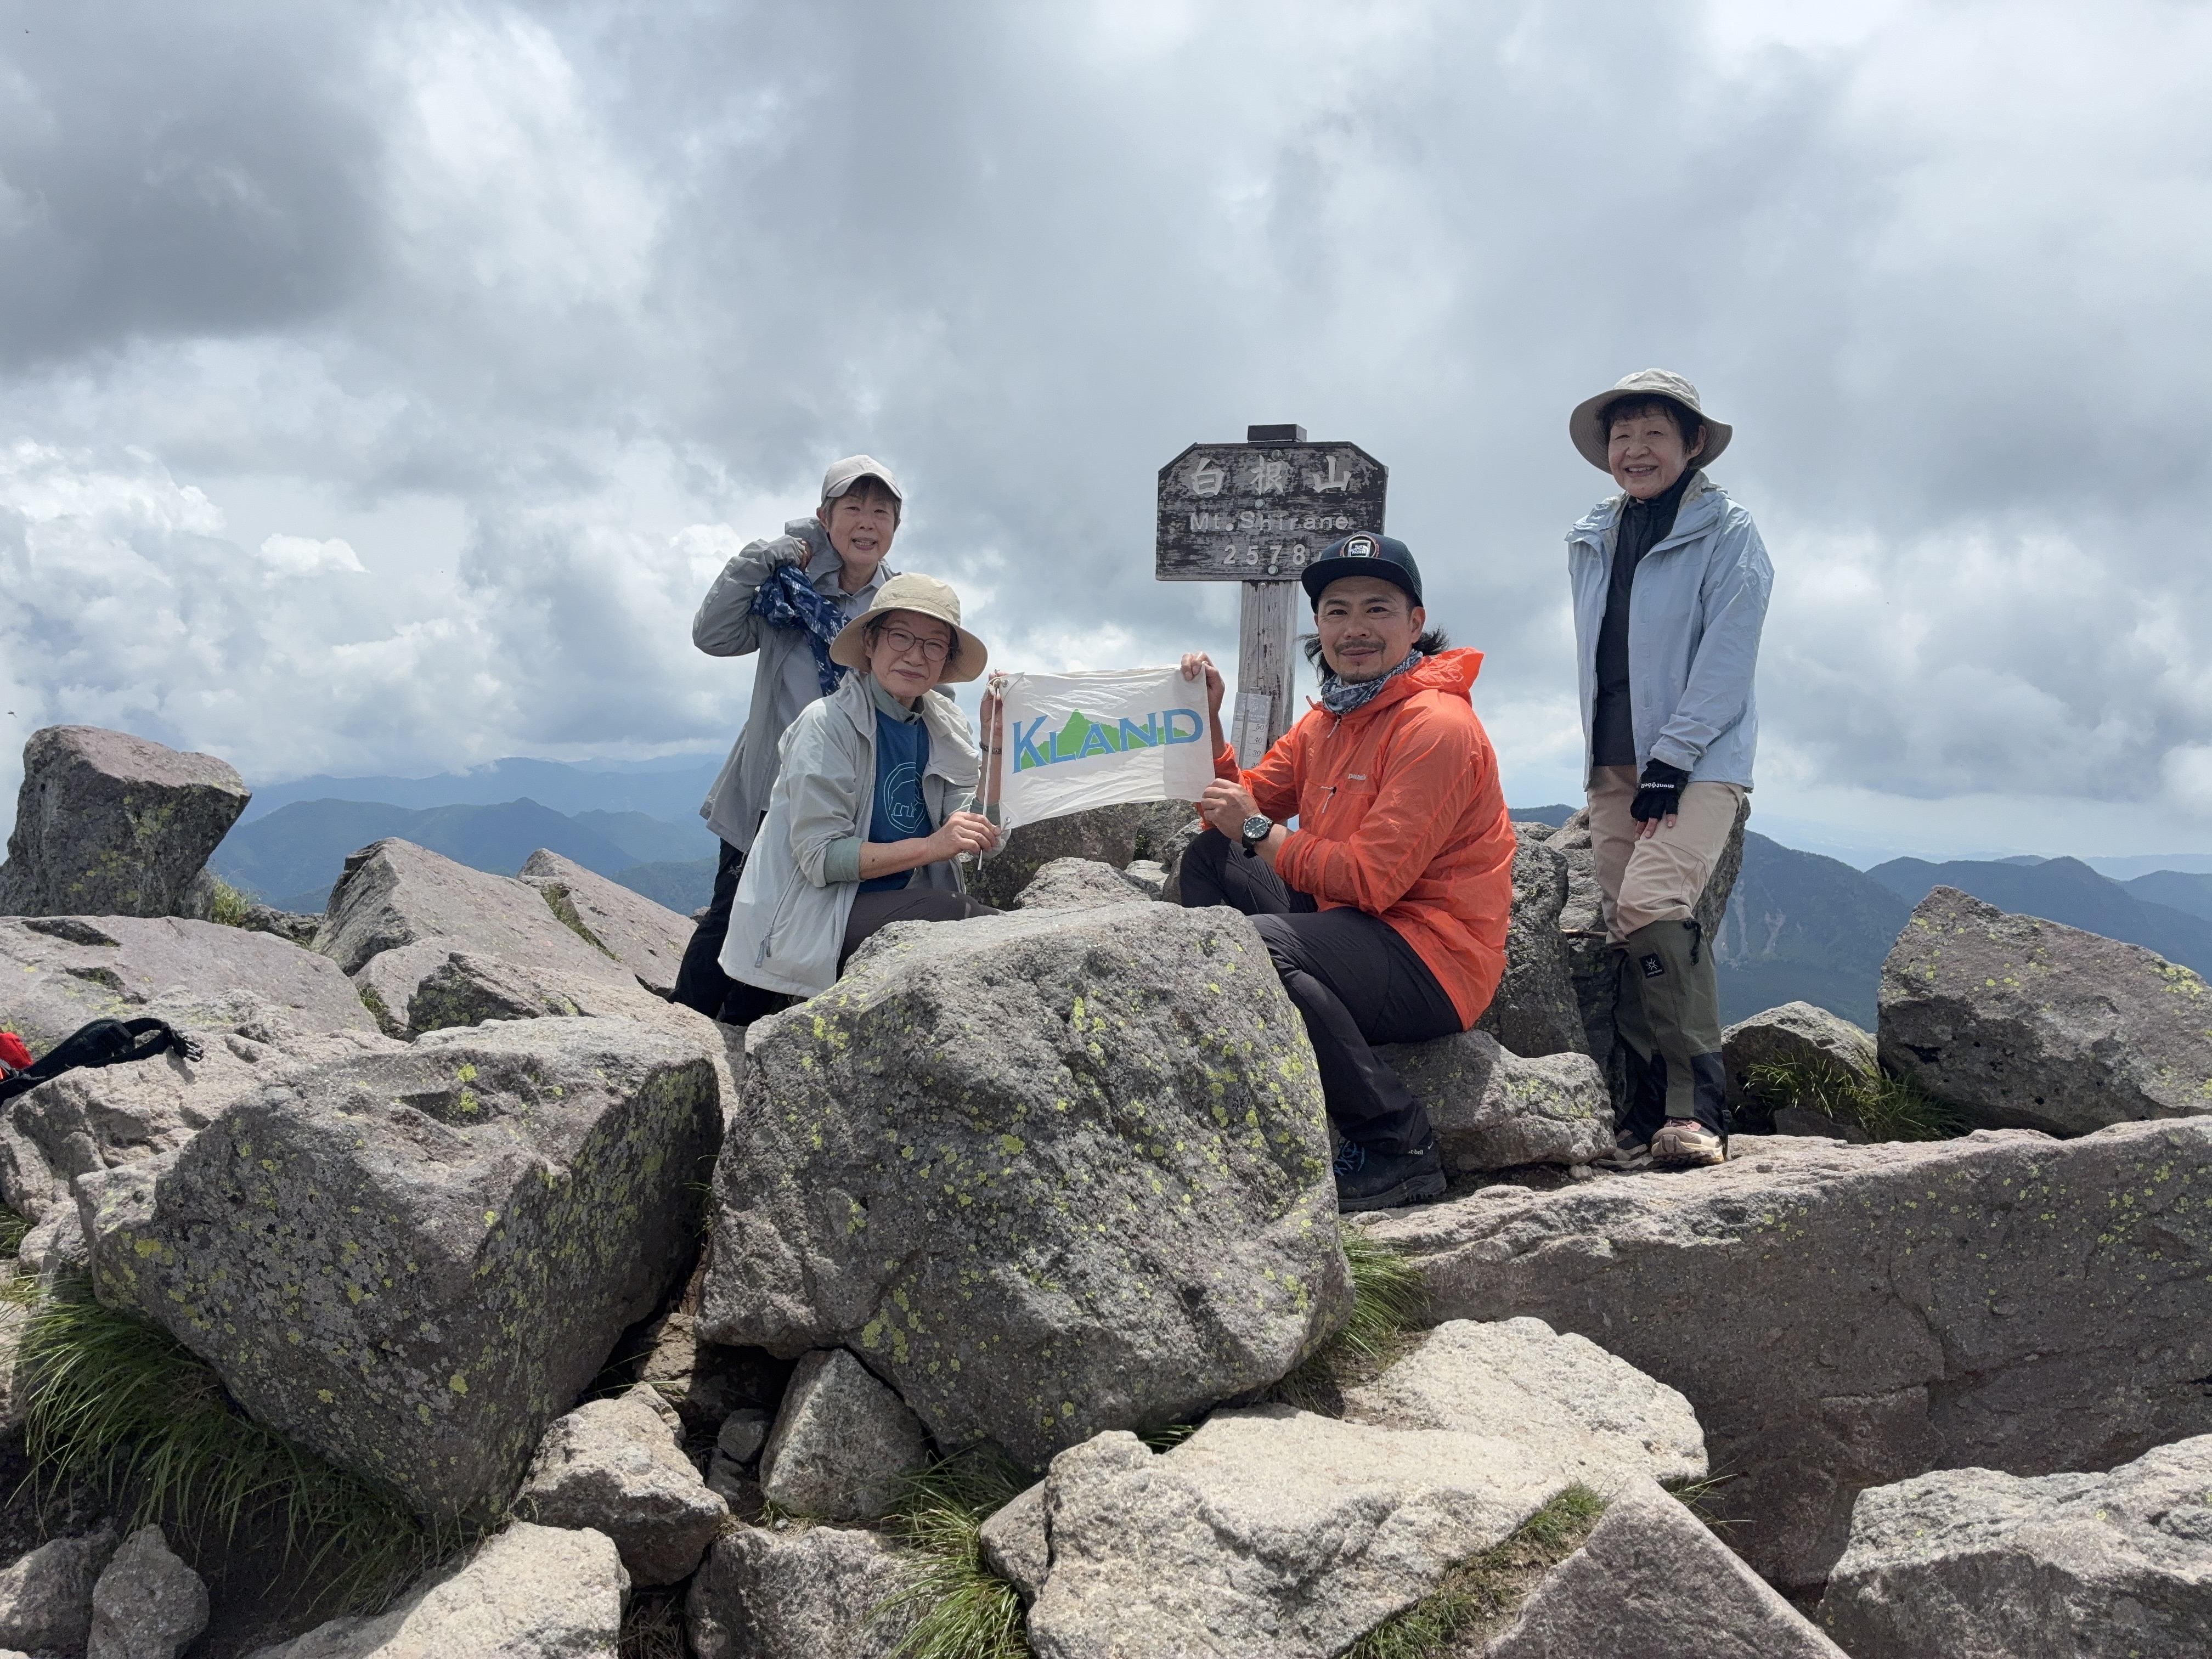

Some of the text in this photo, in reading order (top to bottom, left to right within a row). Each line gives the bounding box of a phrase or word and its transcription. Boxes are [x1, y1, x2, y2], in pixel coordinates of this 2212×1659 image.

[1190, 454, 1351, 495] 白根山
[1012, 708, 1204, 774] KLAND
